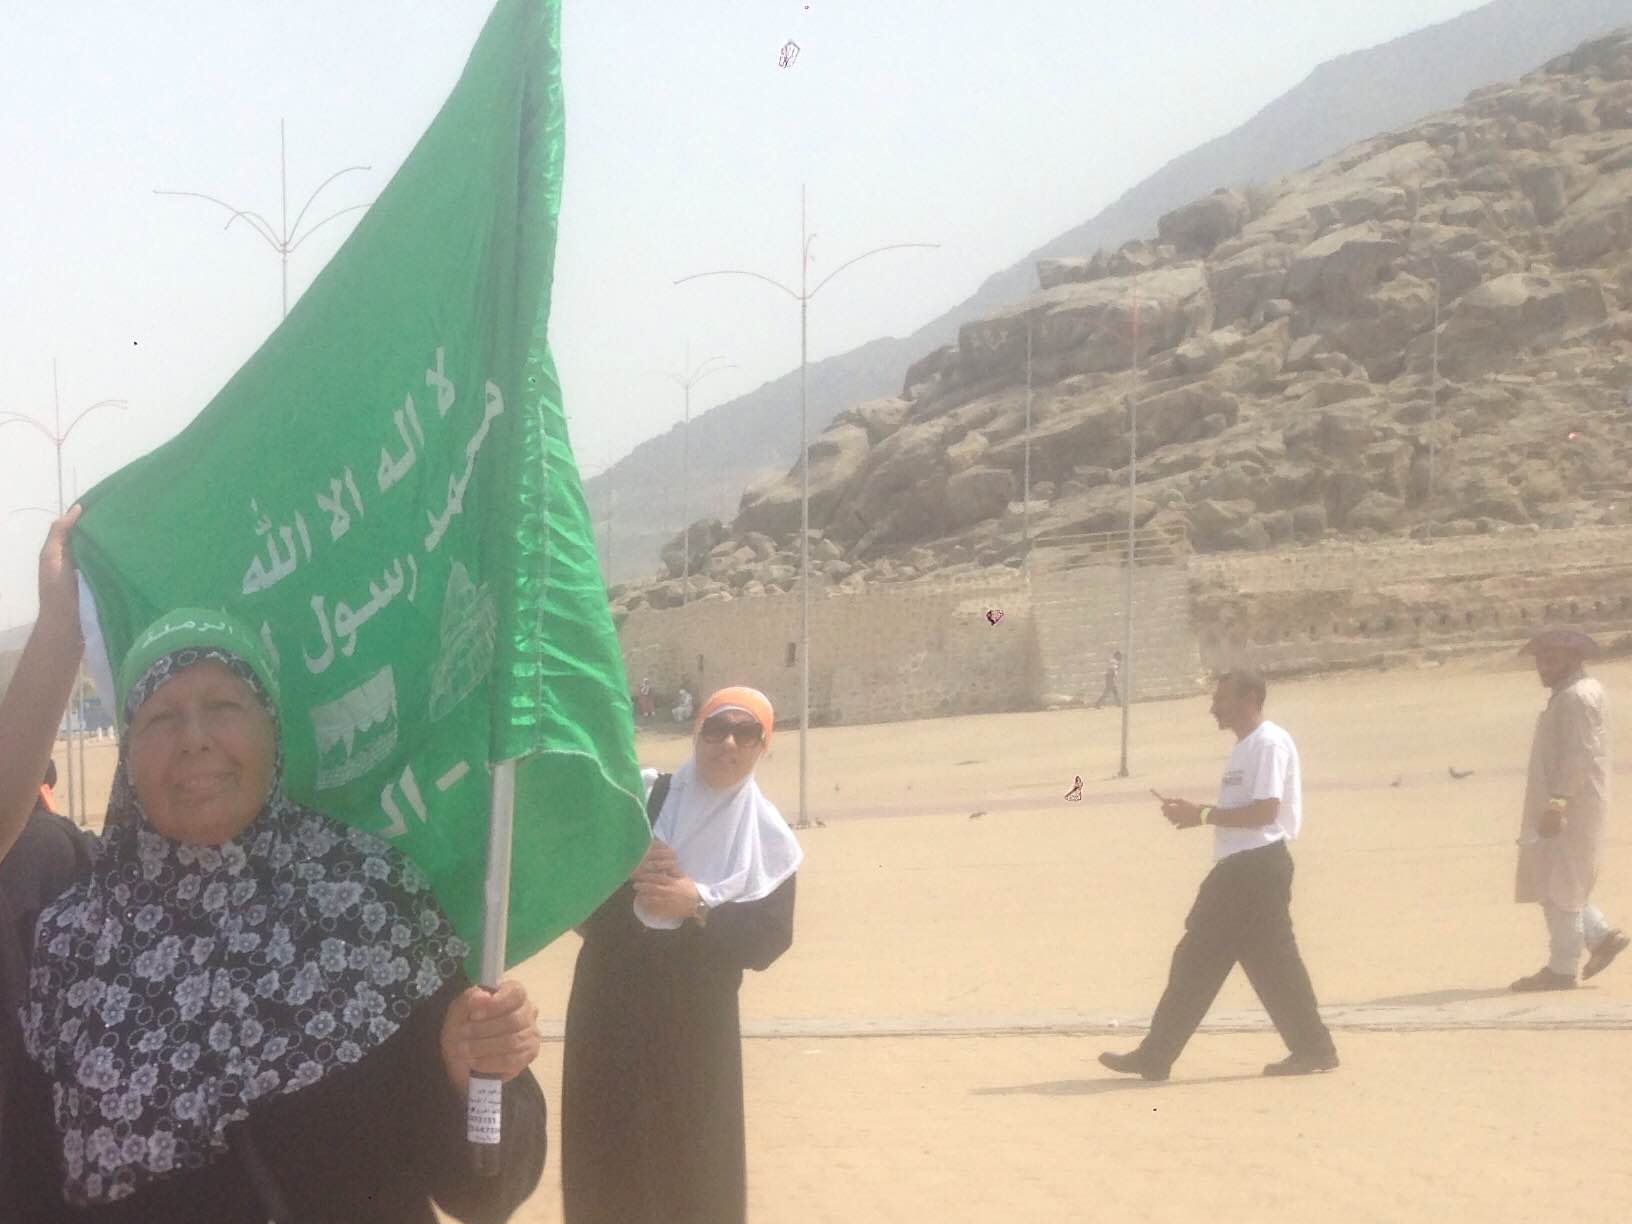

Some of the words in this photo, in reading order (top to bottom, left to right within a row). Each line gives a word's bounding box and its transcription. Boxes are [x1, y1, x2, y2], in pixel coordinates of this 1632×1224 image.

[425, 347, 456, 416] لا
[425, 379, 504, 553] محمد
[242, 498, 313, 596] الله
[304, 554, 419, 675] رسول
